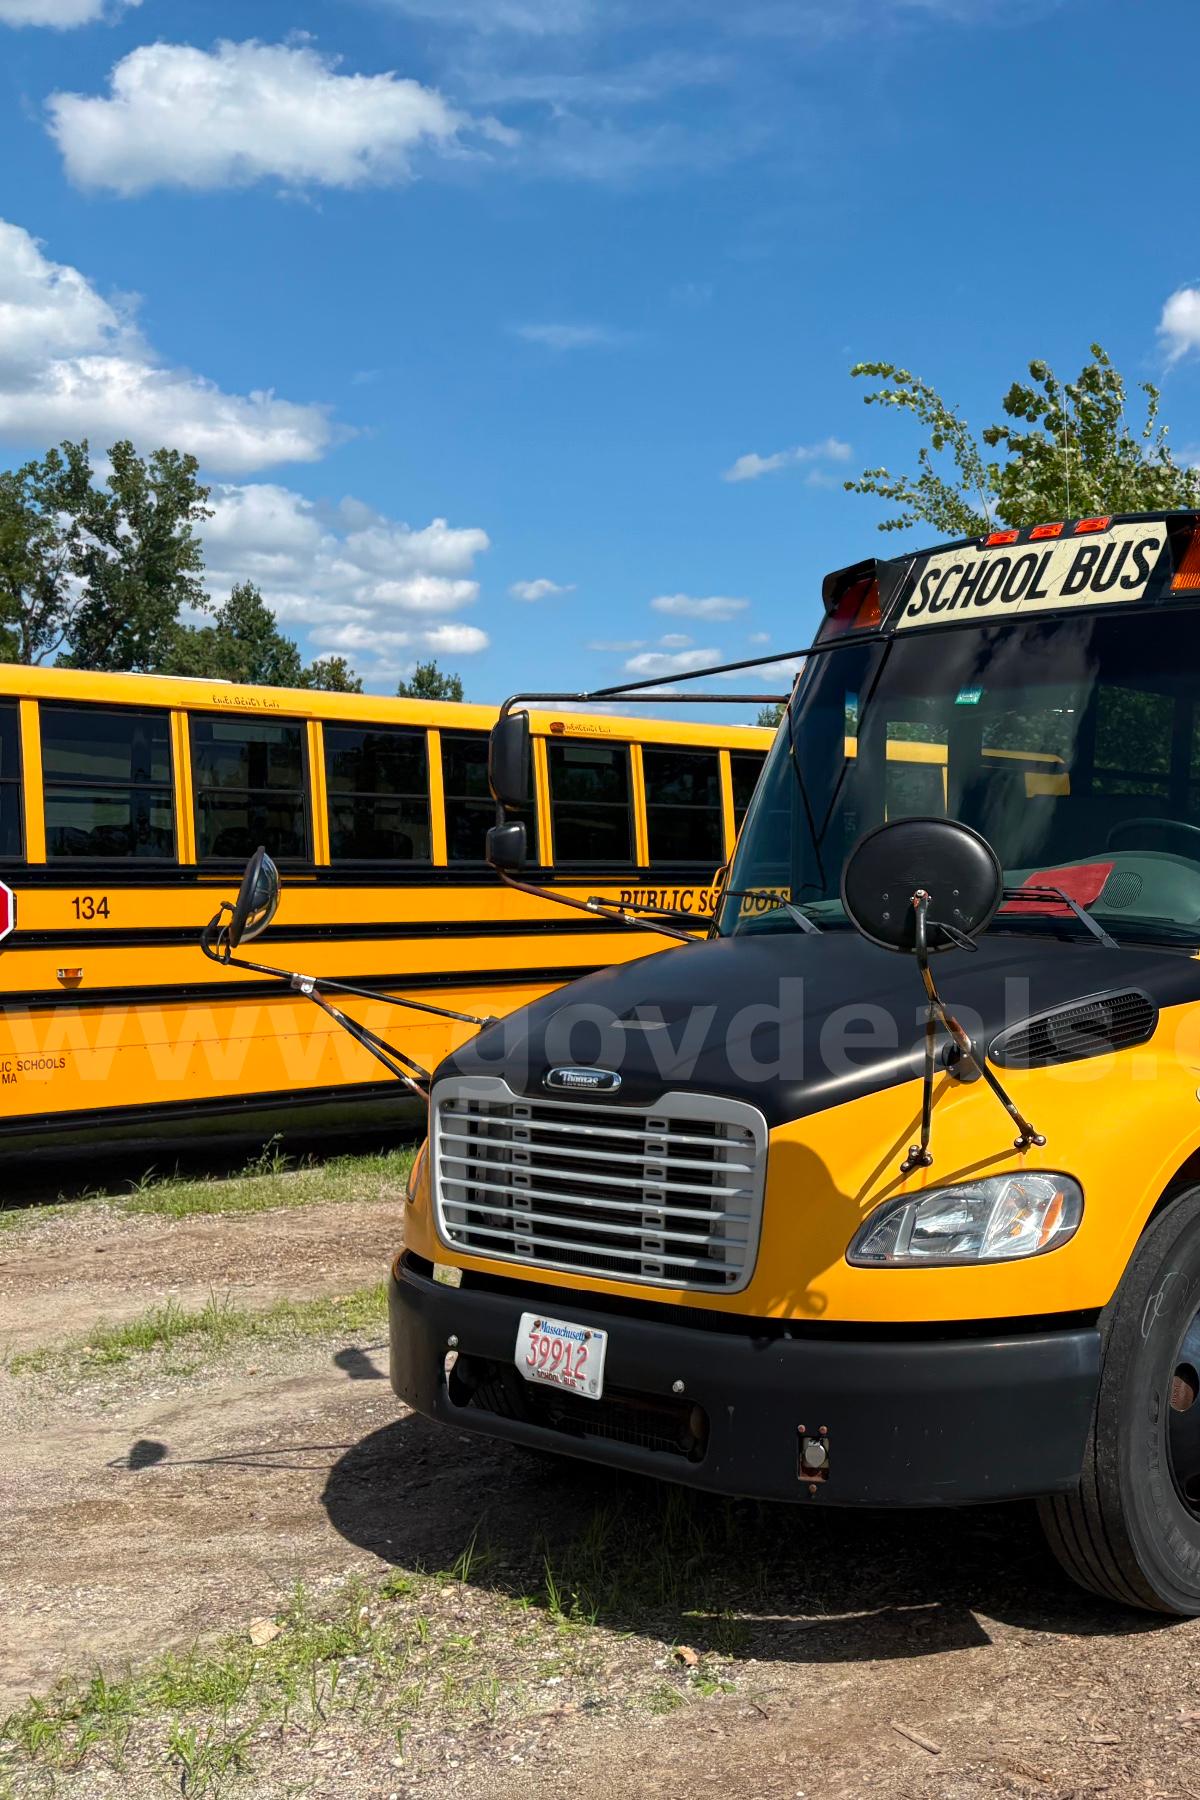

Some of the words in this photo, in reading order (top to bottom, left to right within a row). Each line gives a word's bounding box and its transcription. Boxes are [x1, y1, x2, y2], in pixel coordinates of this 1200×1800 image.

[907, 550, 1054, 617] SCHOOL
[1059, 538, 1160, 596] BUS
[72, 896, 110, 919] 134
[618, 889, 694, 914] PUBLIC
[16, 1058, 66, 1072] SCHOOLS
[2, 1073, 18, 1084] MA
[560, 1071, 599, 1084] Thomas
[541, 1320, 584, 1342] Massachusett
[526, 1333, 588, 1380] 39912
